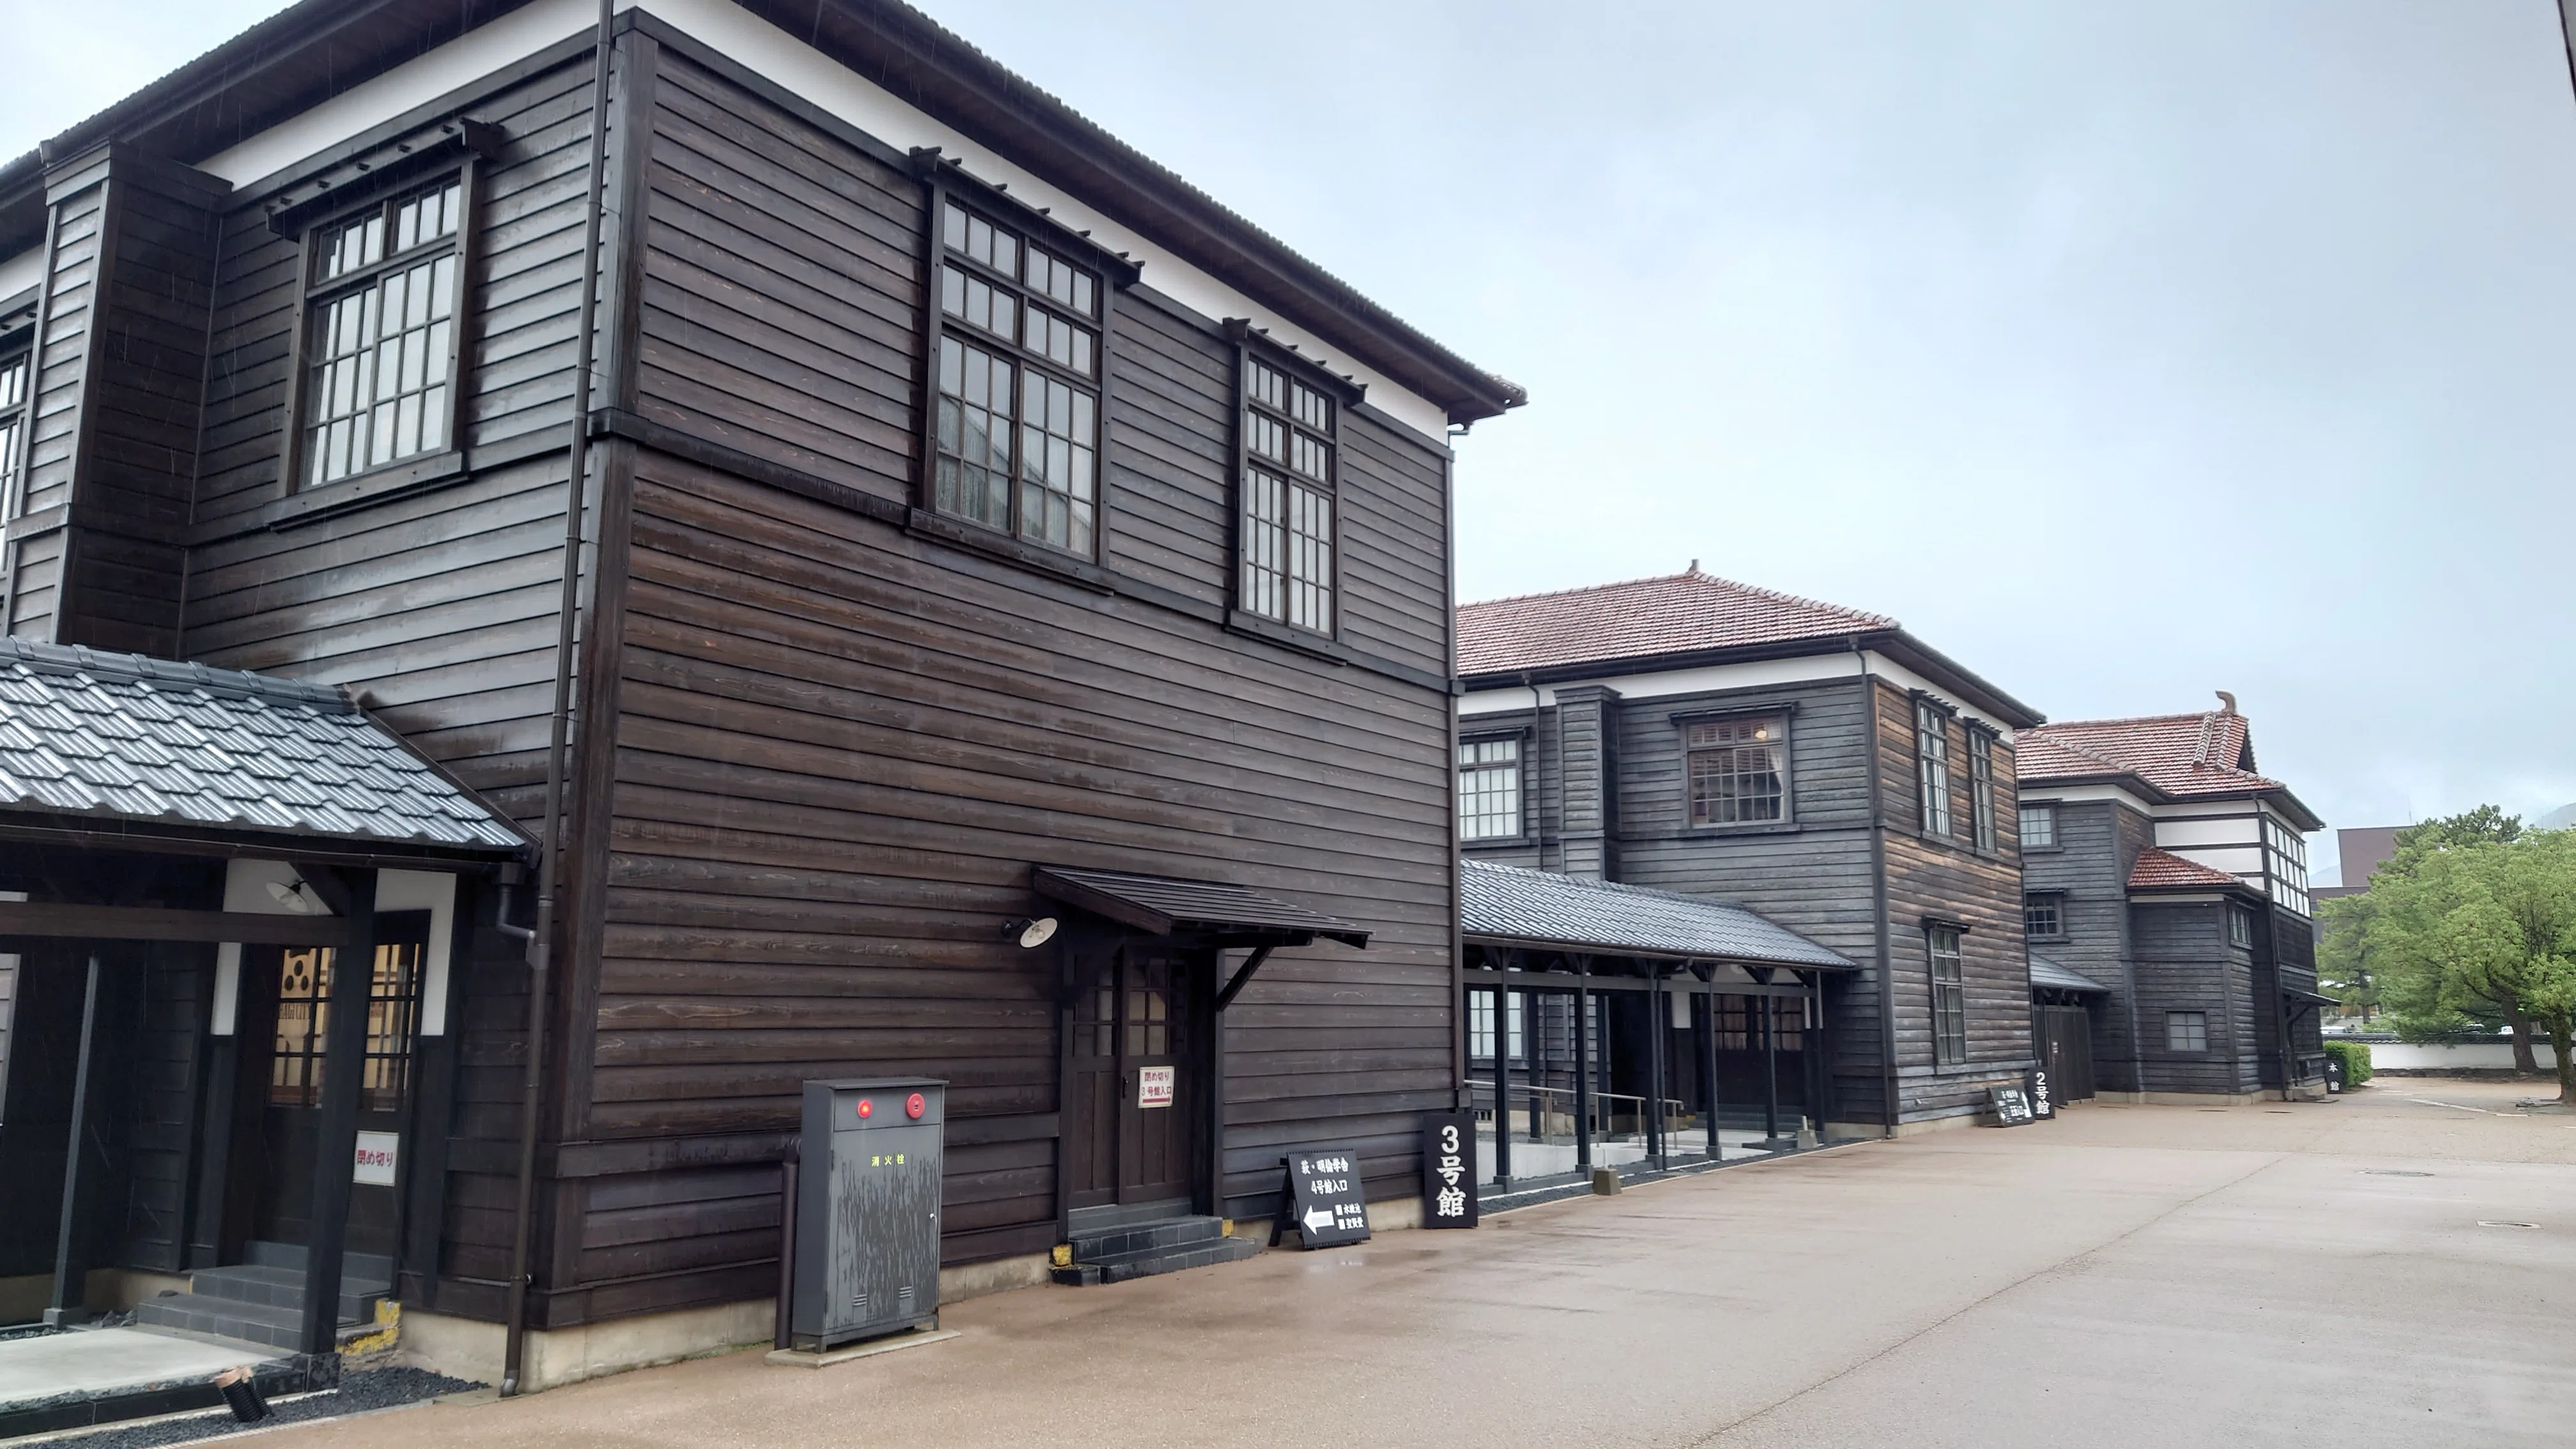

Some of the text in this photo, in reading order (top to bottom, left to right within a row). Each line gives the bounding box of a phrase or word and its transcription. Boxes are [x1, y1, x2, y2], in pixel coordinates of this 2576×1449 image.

[1144, 1071, 1169, 1082] 閉め切り
[2035, 1072, 2050, 1115] 2号館
[357, 1149, 394, 1167] 閉め切り
[871, 1154, 905, 1167] 消火栓
[1436, 1125, 1466, 1217] 3号館
[1311, 1179, 1348, 1195] 4号館入口
